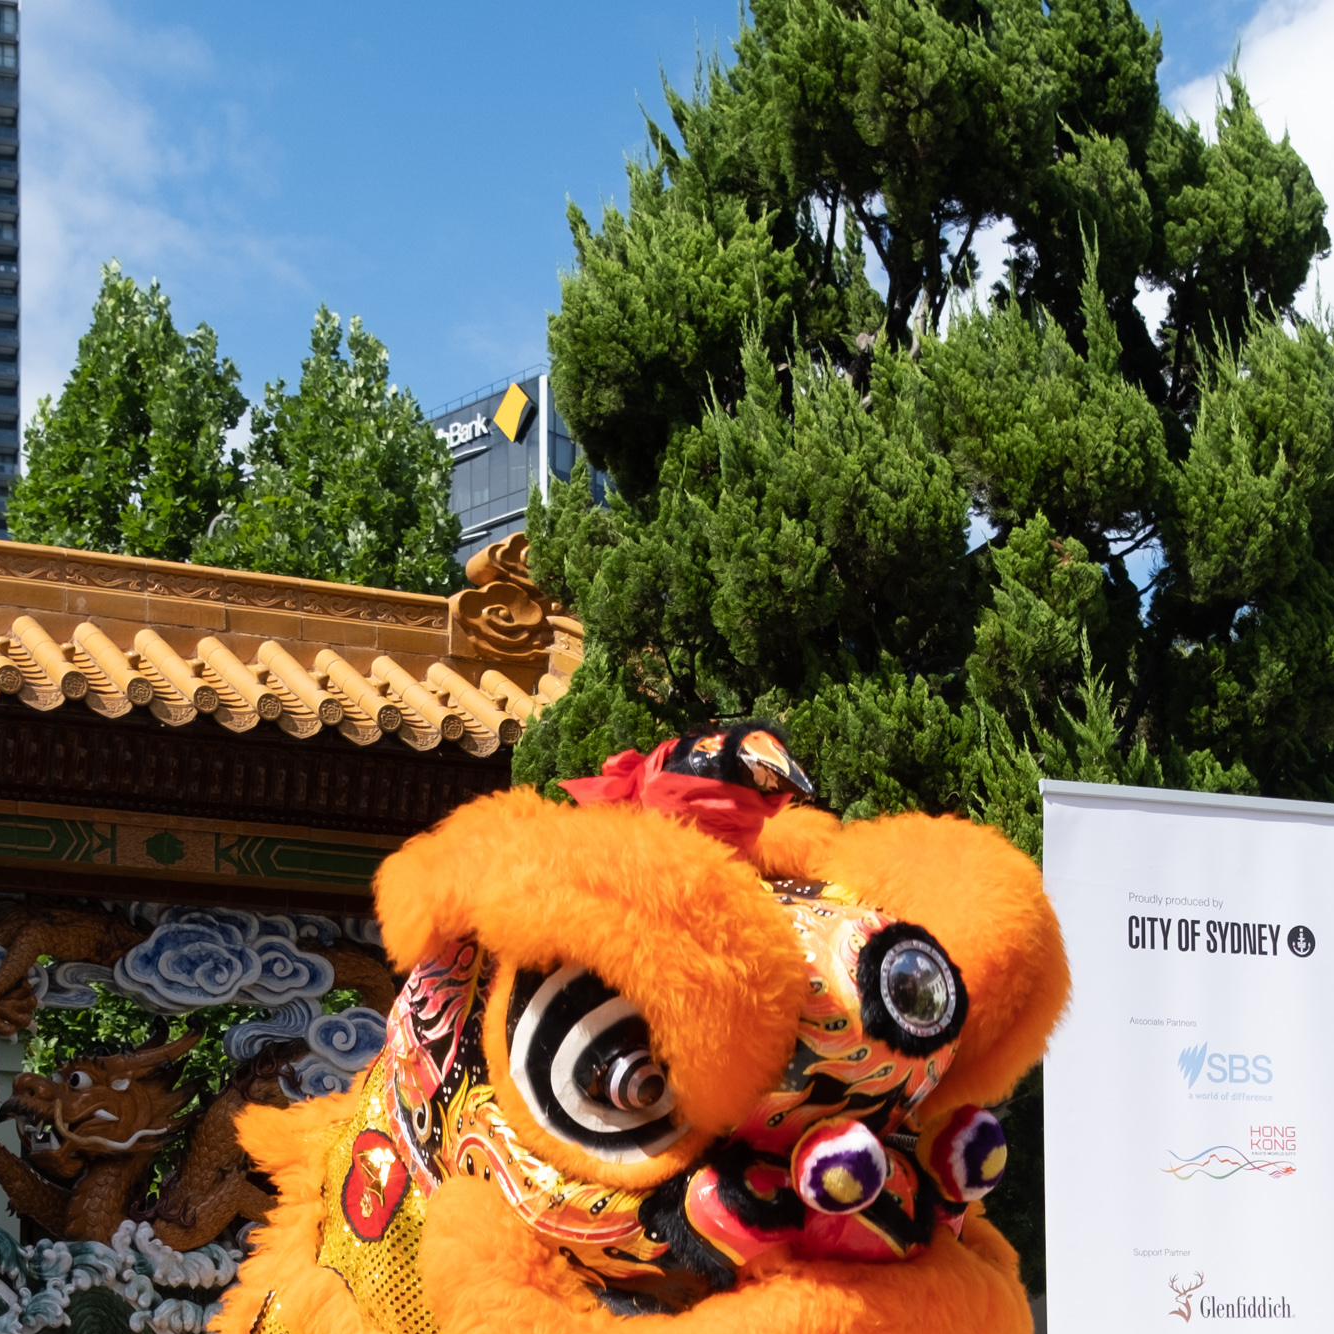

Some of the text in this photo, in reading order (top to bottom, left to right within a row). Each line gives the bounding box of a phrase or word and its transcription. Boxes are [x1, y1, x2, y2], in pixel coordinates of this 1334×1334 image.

[1128, 892, 1224, 910] Proudly produced by
[1128, 915, 1281, 956] CITY OF SYDNEY
[1130, 1017, 1197, 1027] Associate Partners
[1207, 1053, 1273, 1084] SBS
[1195, 1092, 1218, 1101] world
[1220, 1092, 1230, 1101] of
[1231, 1093, 1273, 1102] difference
[1250, 1126, 1296, 1138] HONG
[1250, 1139, 1296, 1151] KONG
[1133, 1248, 1191, 1258] Support Partner
[1200, 1296, 1292, 1319] Glenfiddich
